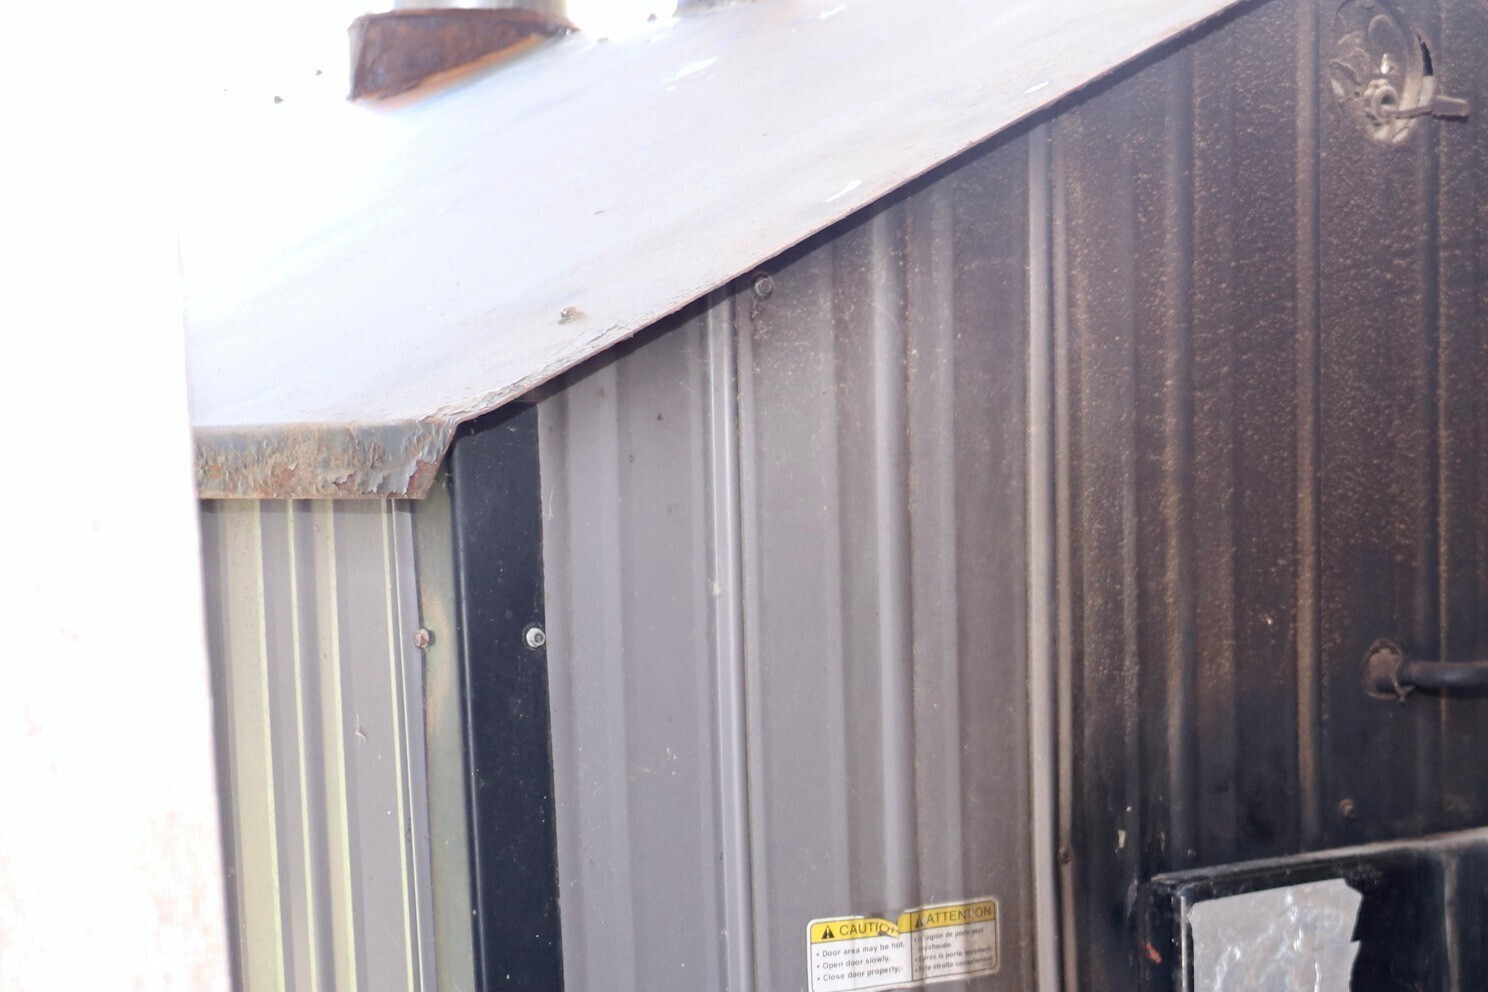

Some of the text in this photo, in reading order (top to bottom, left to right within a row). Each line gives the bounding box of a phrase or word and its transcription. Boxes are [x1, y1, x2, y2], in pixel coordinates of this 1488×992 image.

[822, 949, 841, 957] Door
[862, 945, 878, 953] may
[891, 941, 905, 949] hot.
[822, 955, 890, 970] Open door slowly.
[823, 965, 900, 982] Close door properly.
